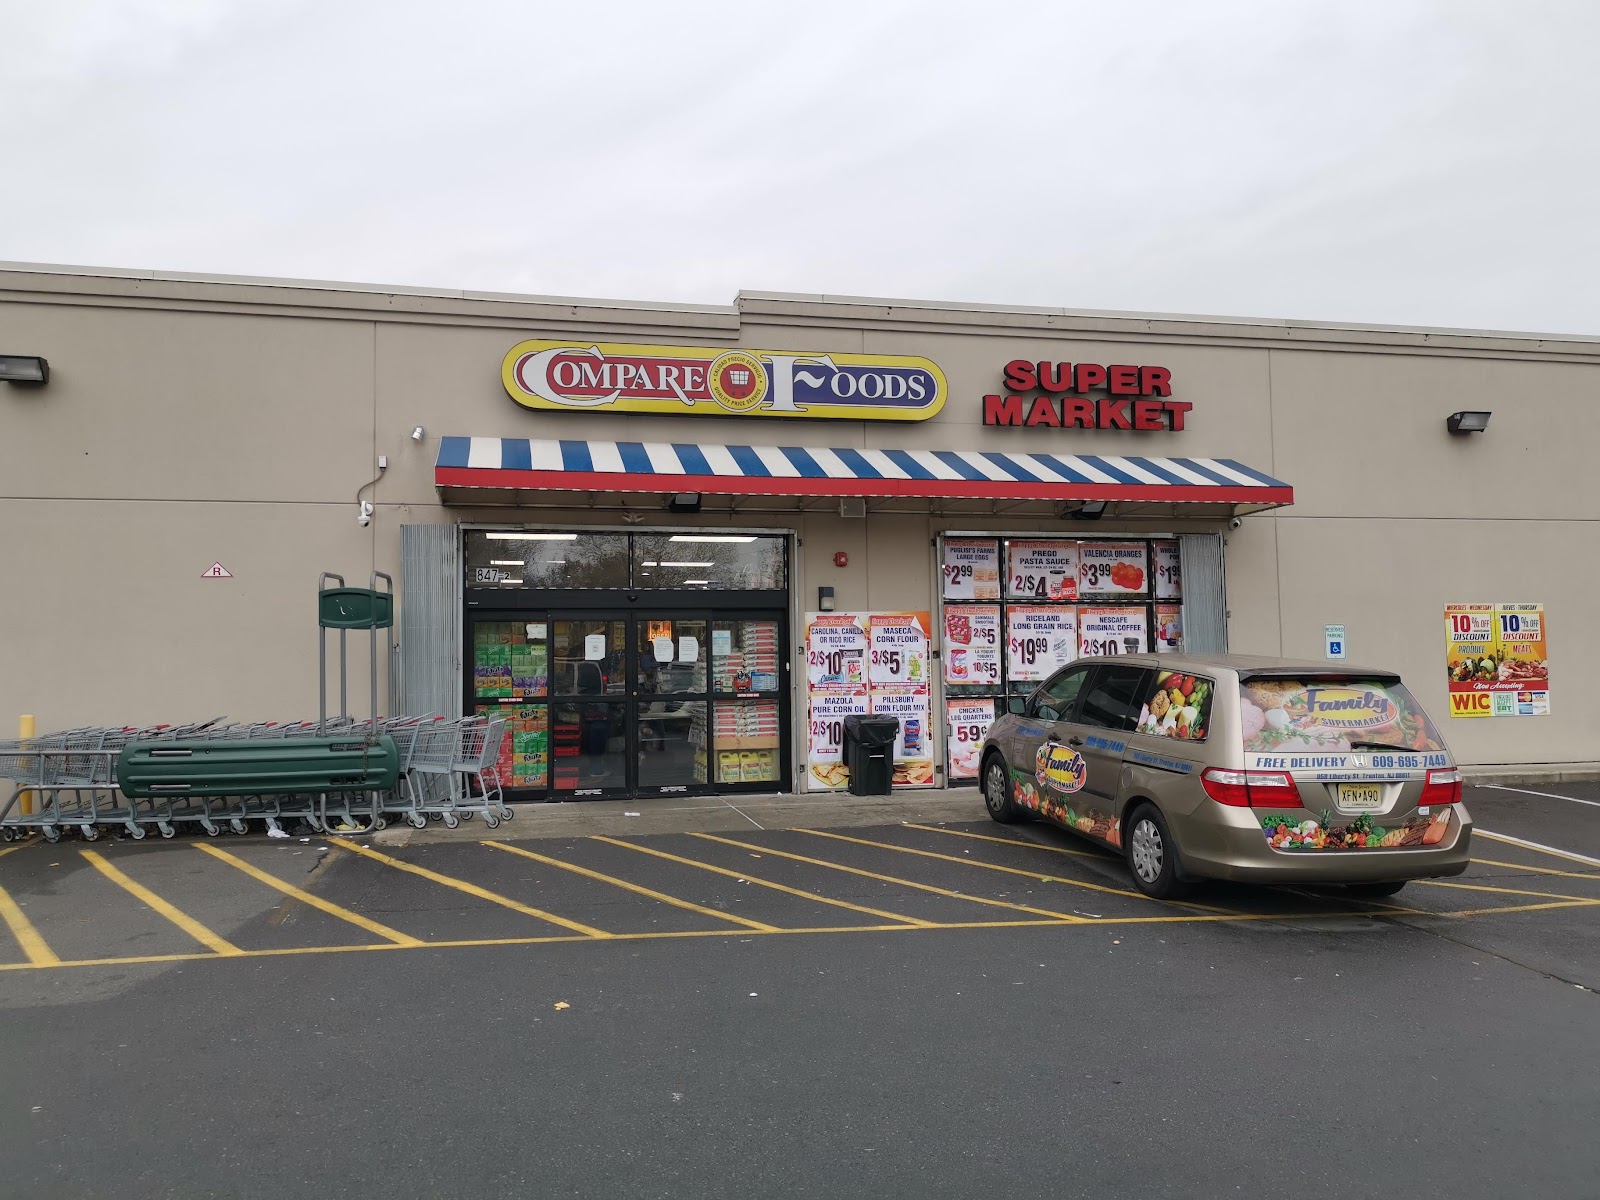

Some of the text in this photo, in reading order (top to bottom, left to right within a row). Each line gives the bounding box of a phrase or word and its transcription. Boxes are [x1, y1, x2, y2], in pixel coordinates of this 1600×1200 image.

[521, 345, 926, 412] COMPARE FOODS
[1003, 360, 1172, 396] SUPER
[982, 395, 1192, 431] MARKET
[1084, 550, 1113, 558] VALENCIA
[213, 568, 220, 576] R
[1458, 645, 1485, 654] PRODUCE
[1513, 644, 1532, 653] MEATS
[1306, 689, 1388, 713] Family
[1452, 694, 1490, 710] WIC
[1321, 713, 1389, 727] SUPERMARKET
[1046, 745, 1084, 779] Family
[1256, 758, 1287, 768] FREE
[1291, 757, 1346, 768] DELIVERY
